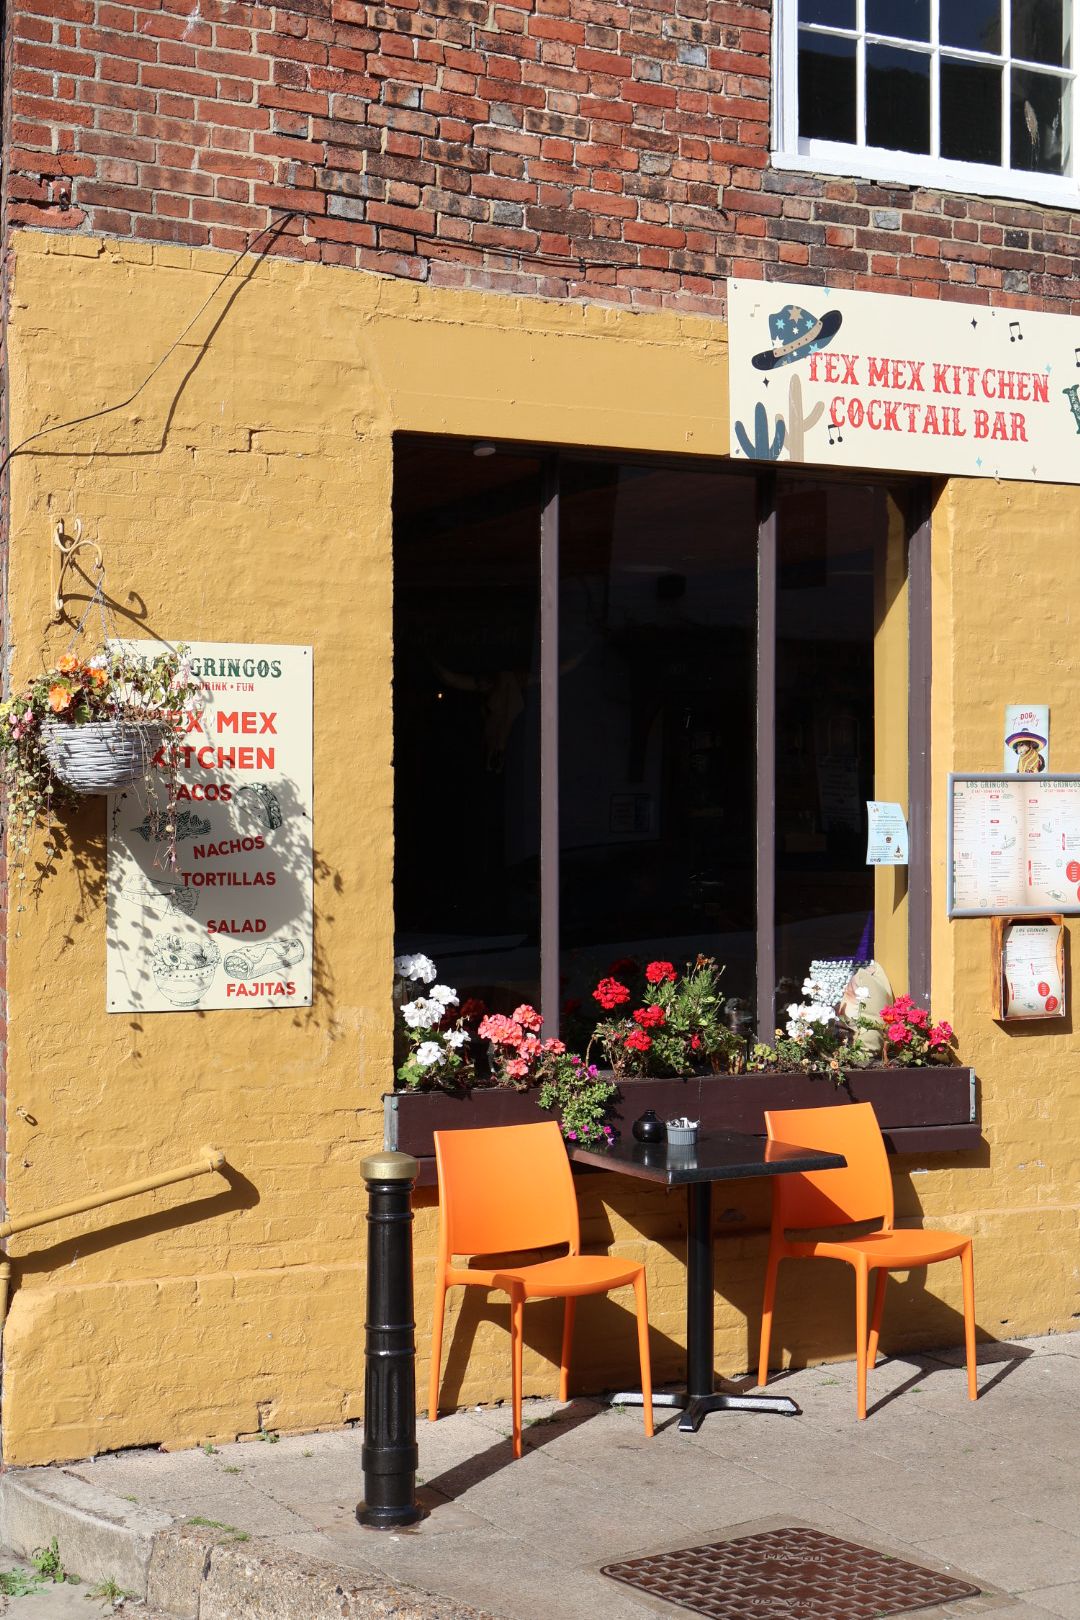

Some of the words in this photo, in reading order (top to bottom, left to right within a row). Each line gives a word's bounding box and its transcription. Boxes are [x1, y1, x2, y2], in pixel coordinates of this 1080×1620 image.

[808, 351, 859, 386] TEX
[867, 356, 926, 392] MEX
[932, 363, 1050, 403] KITCHEN
[829, 396, 968, 437] COCKTAIL
[973, 409, 1029, 442] BAR
[189, 657, 282, 679] GRINGOS
[236, 683, 255, 692] FUN
[158, 710, 204, 734] EX
[217, 711, 278, 735] MEX
[193, 835, 266, 860] NACHOS
[180, 871, 276, 888] TORTILLAS
[207, 919, 267, 934] SALAD
[226, 981, 297, 998] FAJITAS
